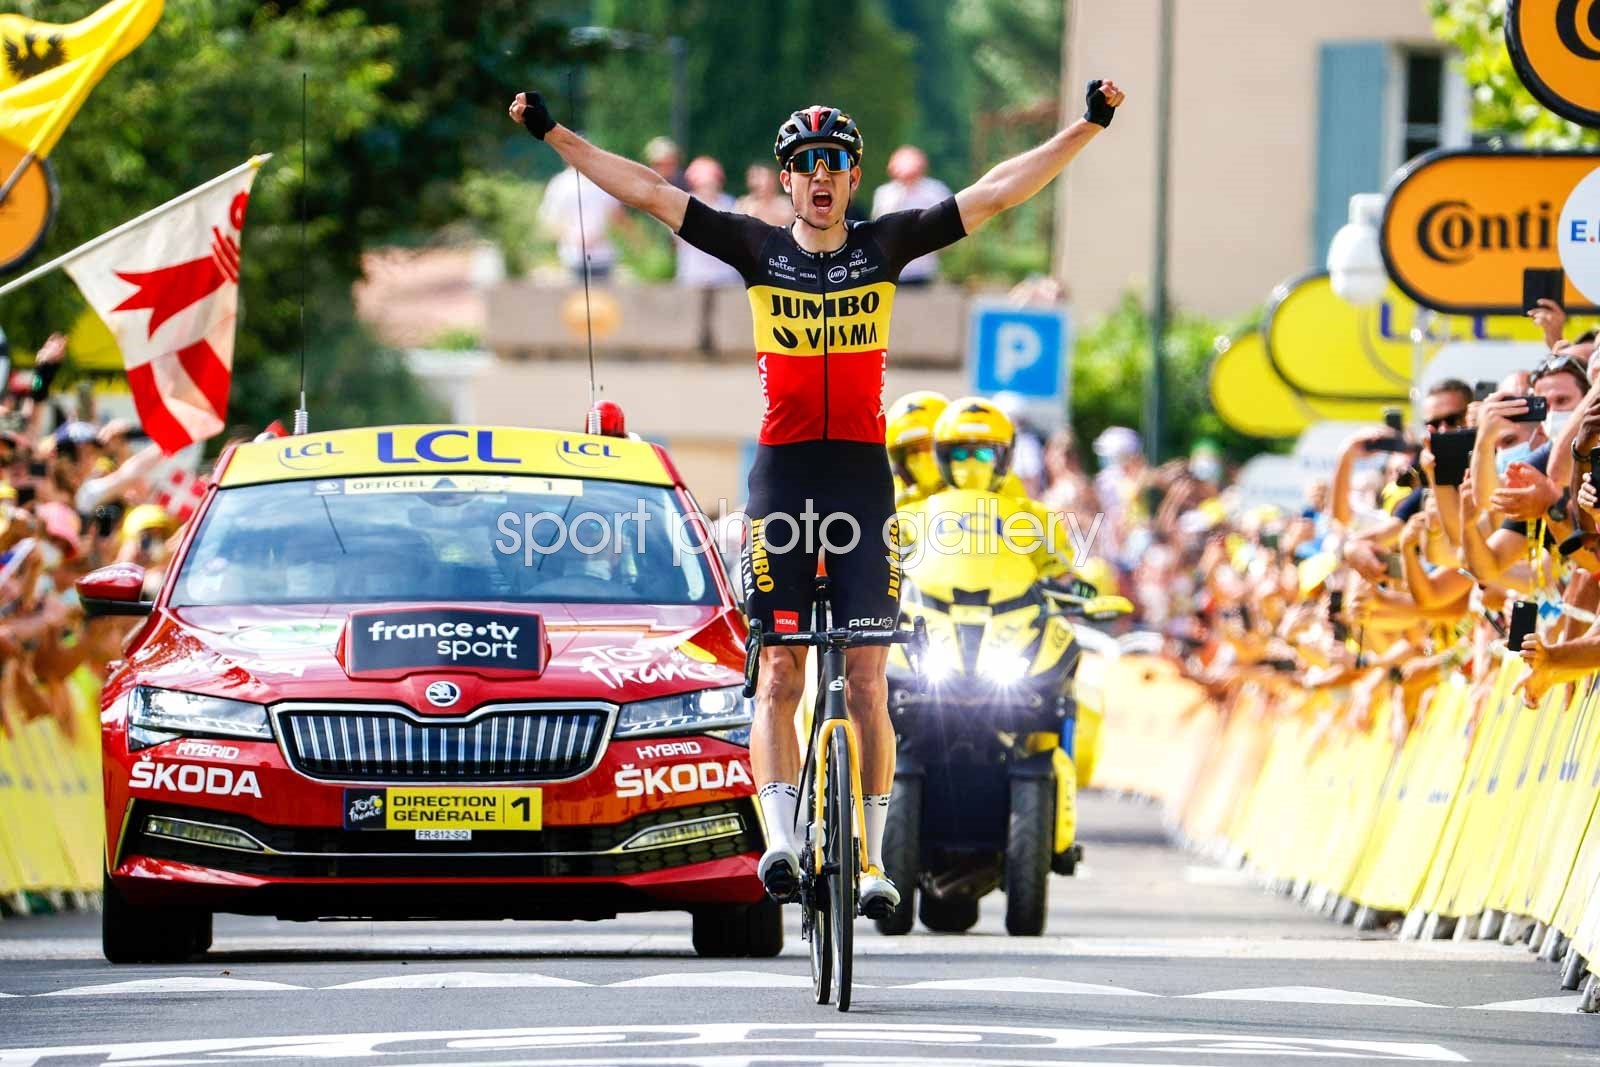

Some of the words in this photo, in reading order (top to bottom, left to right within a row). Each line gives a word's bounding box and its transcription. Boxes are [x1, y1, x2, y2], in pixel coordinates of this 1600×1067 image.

[832, 130, 856, 143] LAZER
[1570, 218, 1600, 243] E.
[768, 257, 797, 273] Better
[849, 257, 868, 267] AGU
[770, 291, 880, 320] JUMBO
[804, 321, 878, 349] VISMA
[995, 322, 1042, 384] P
[284, 440, 344, 460] LCL
[376, 430, 522, 464] LCL
[562, 440, 622, 459] LCL
[352, 479, 427, 490] OFFICIEL
[751, 518, 775, 593] JUMBO
[776, 618, 797, 626] HEMA
[848, 617, 883, 629] AGU
[436, 638, 518, 661] sport
[175, 743, 239, 760] HYBRID
[636, 741, 700, 760] HYBRID
[128, 754, 263, 798] ŠKODA
[614, 760, 752, 798] ŠKODA
[393, 796, 496, 807] DIRECTION
[511, 796, 530, 822] 1
[393, 808, 496, 822] GÉNÉRALE
[418, 830, 469, 839] FR-812-SQ
